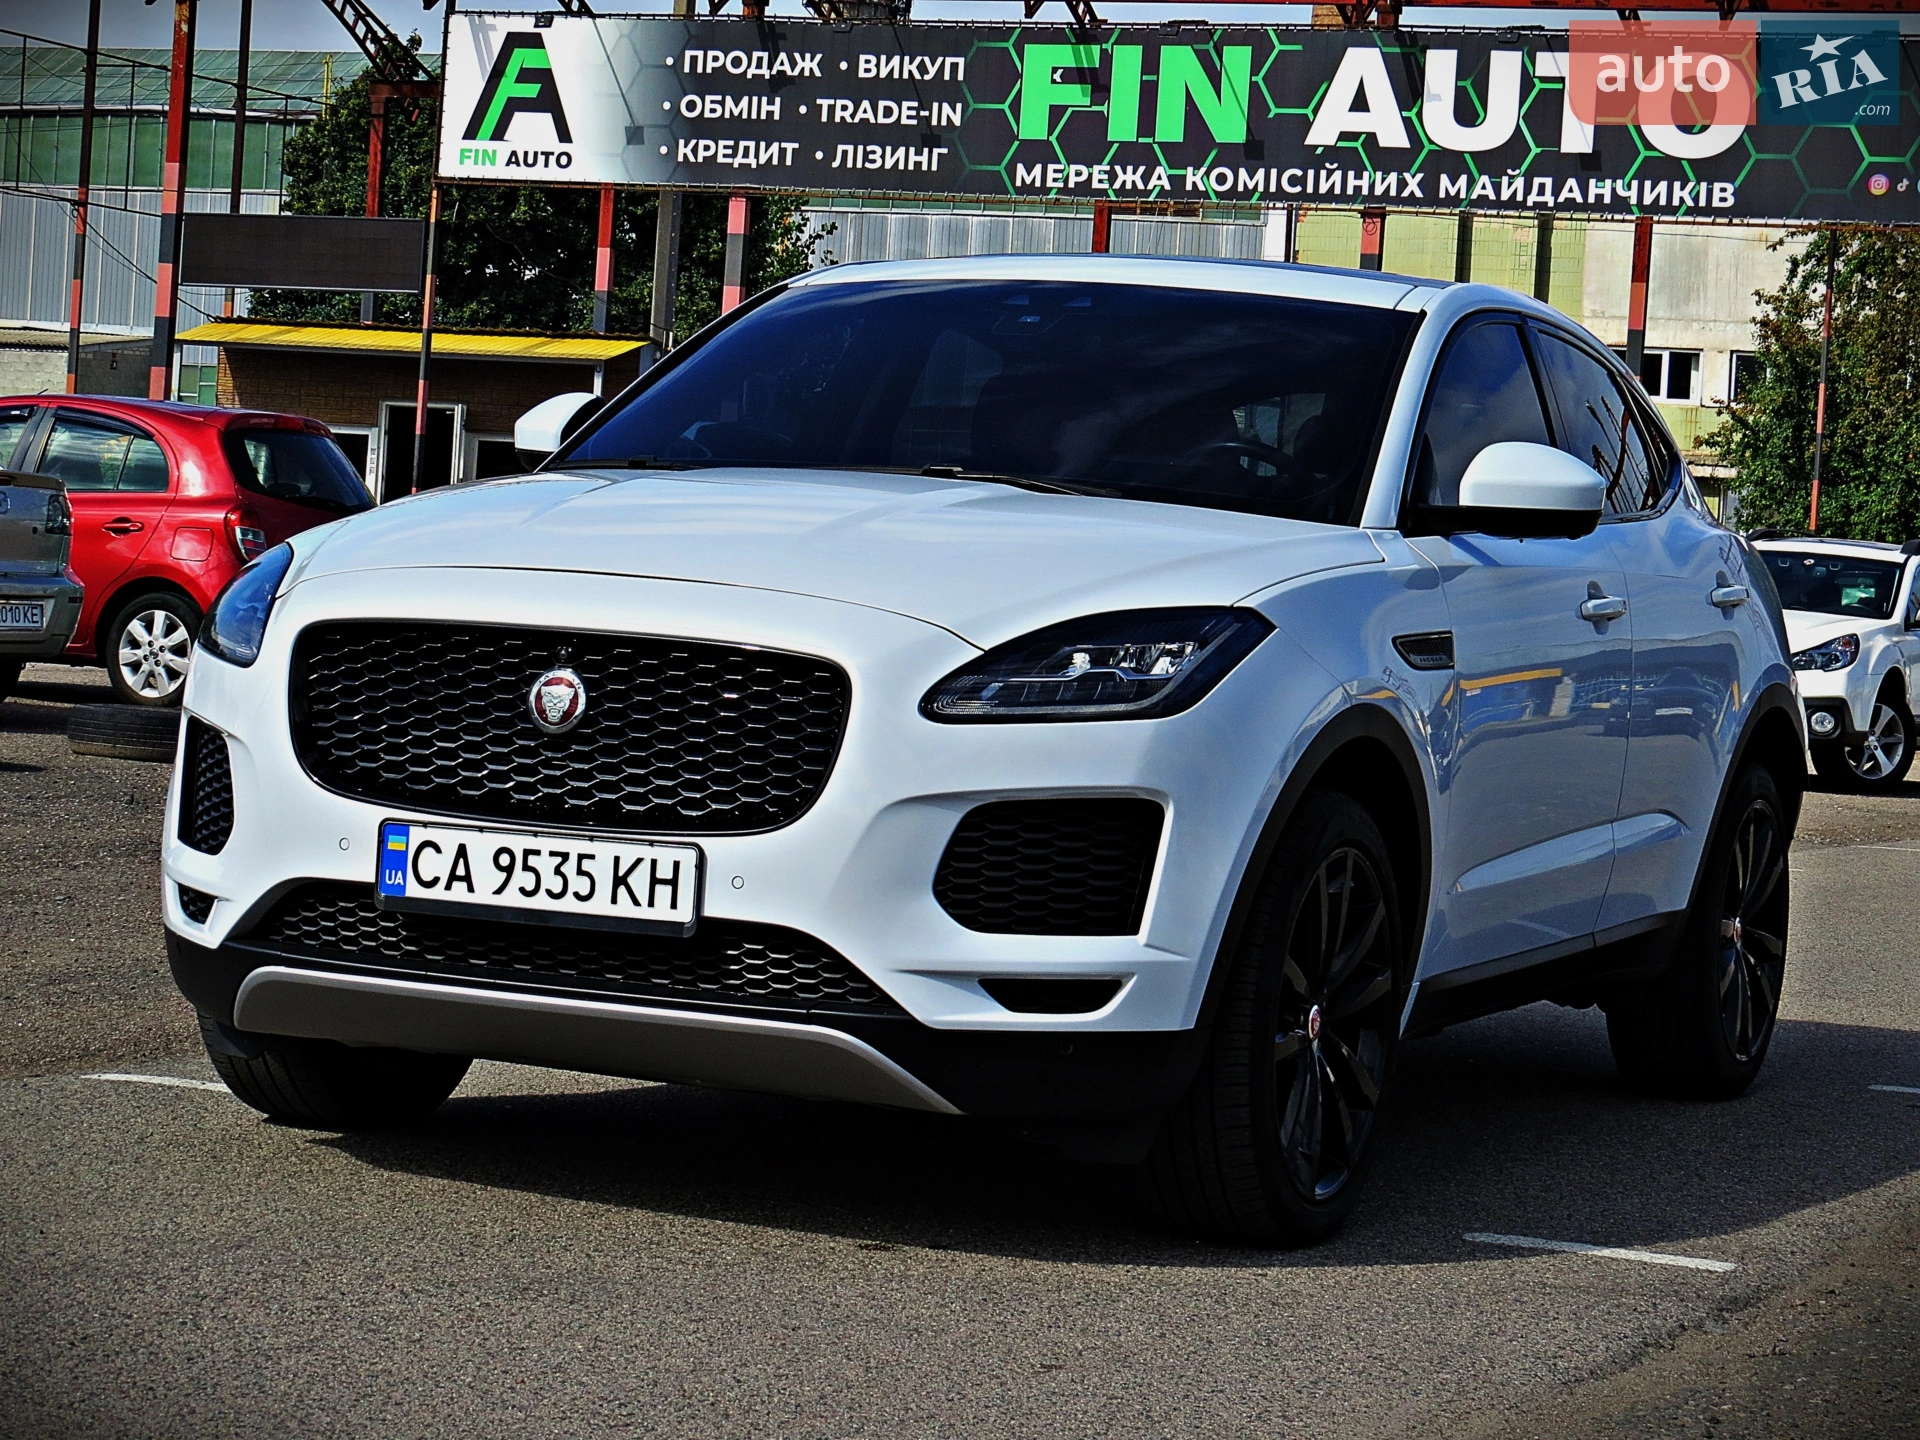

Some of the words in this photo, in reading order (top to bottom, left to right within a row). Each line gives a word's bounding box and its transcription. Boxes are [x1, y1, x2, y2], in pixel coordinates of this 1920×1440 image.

[683, 50, 823, 78] ПРОДАЖ
[858, 54, 965, 81] ВИКУП
[679, 94, 781, 120] ОБМІН
[816, 98, 963, 126] TRADE-IN
[1018, 43, 1253, 143] FIN
[1304, 46, 1748, 159] AUTO
[459, 148, 497, 166] FIN
[505, 150, 573, 169] AUTO
[677, 139, 800, 167] КРЕДИТ
[831, 143, 949, 171] ЛІЗИНГ
[1015, 163, 1171, 191] МЕРЕЖА
[1185, 163, 1424, 199] КОМІСІЙНИХ
[1439, 169, 1736, 208] МАЙДАНЧИКІВ
[23, 605, 40, 624] KE
[385, 869, 405, 886] UA
[411, 840, 476, 894] CA
[491, 846, 597, 903] 9535
[610, 855, 681, 910] KH
